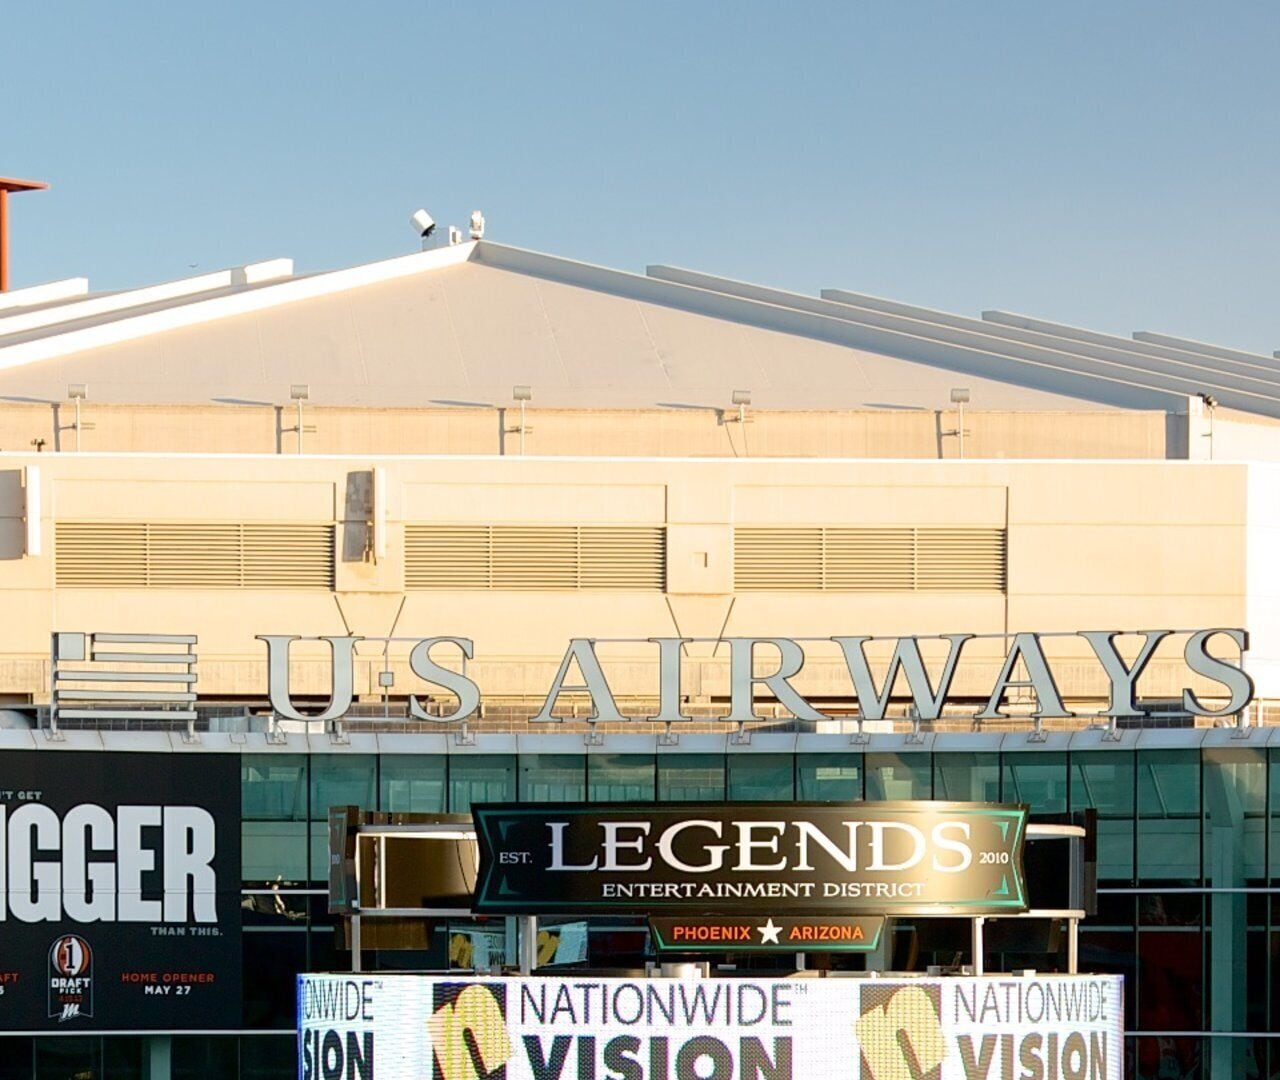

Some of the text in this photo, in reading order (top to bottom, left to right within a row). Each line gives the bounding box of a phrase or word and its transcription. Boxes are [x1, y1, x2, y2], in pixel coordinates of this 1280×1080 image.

[528, 629, 1255, 722] AIRWAYS
[17, 791, 42, 800] GET
[499, 819, 1009, 873] EST. LEGENDS 2010
[602, 883, 926, 898] ENTERTAINMENT DISTRICT
[150, 927, 185, 936] THAN
[673, 926, 865, 940] PHOENIX ARIZONA
[51, 978, 90, 988] DRAFT
[121, 973, 214, 983] HOME OPENER
[144, 985, 191, 995] MAY 27
[520, 983, 792, 1026] NATIONWIDE
[954, 981, 1107, 1024] NATIONWIDE
